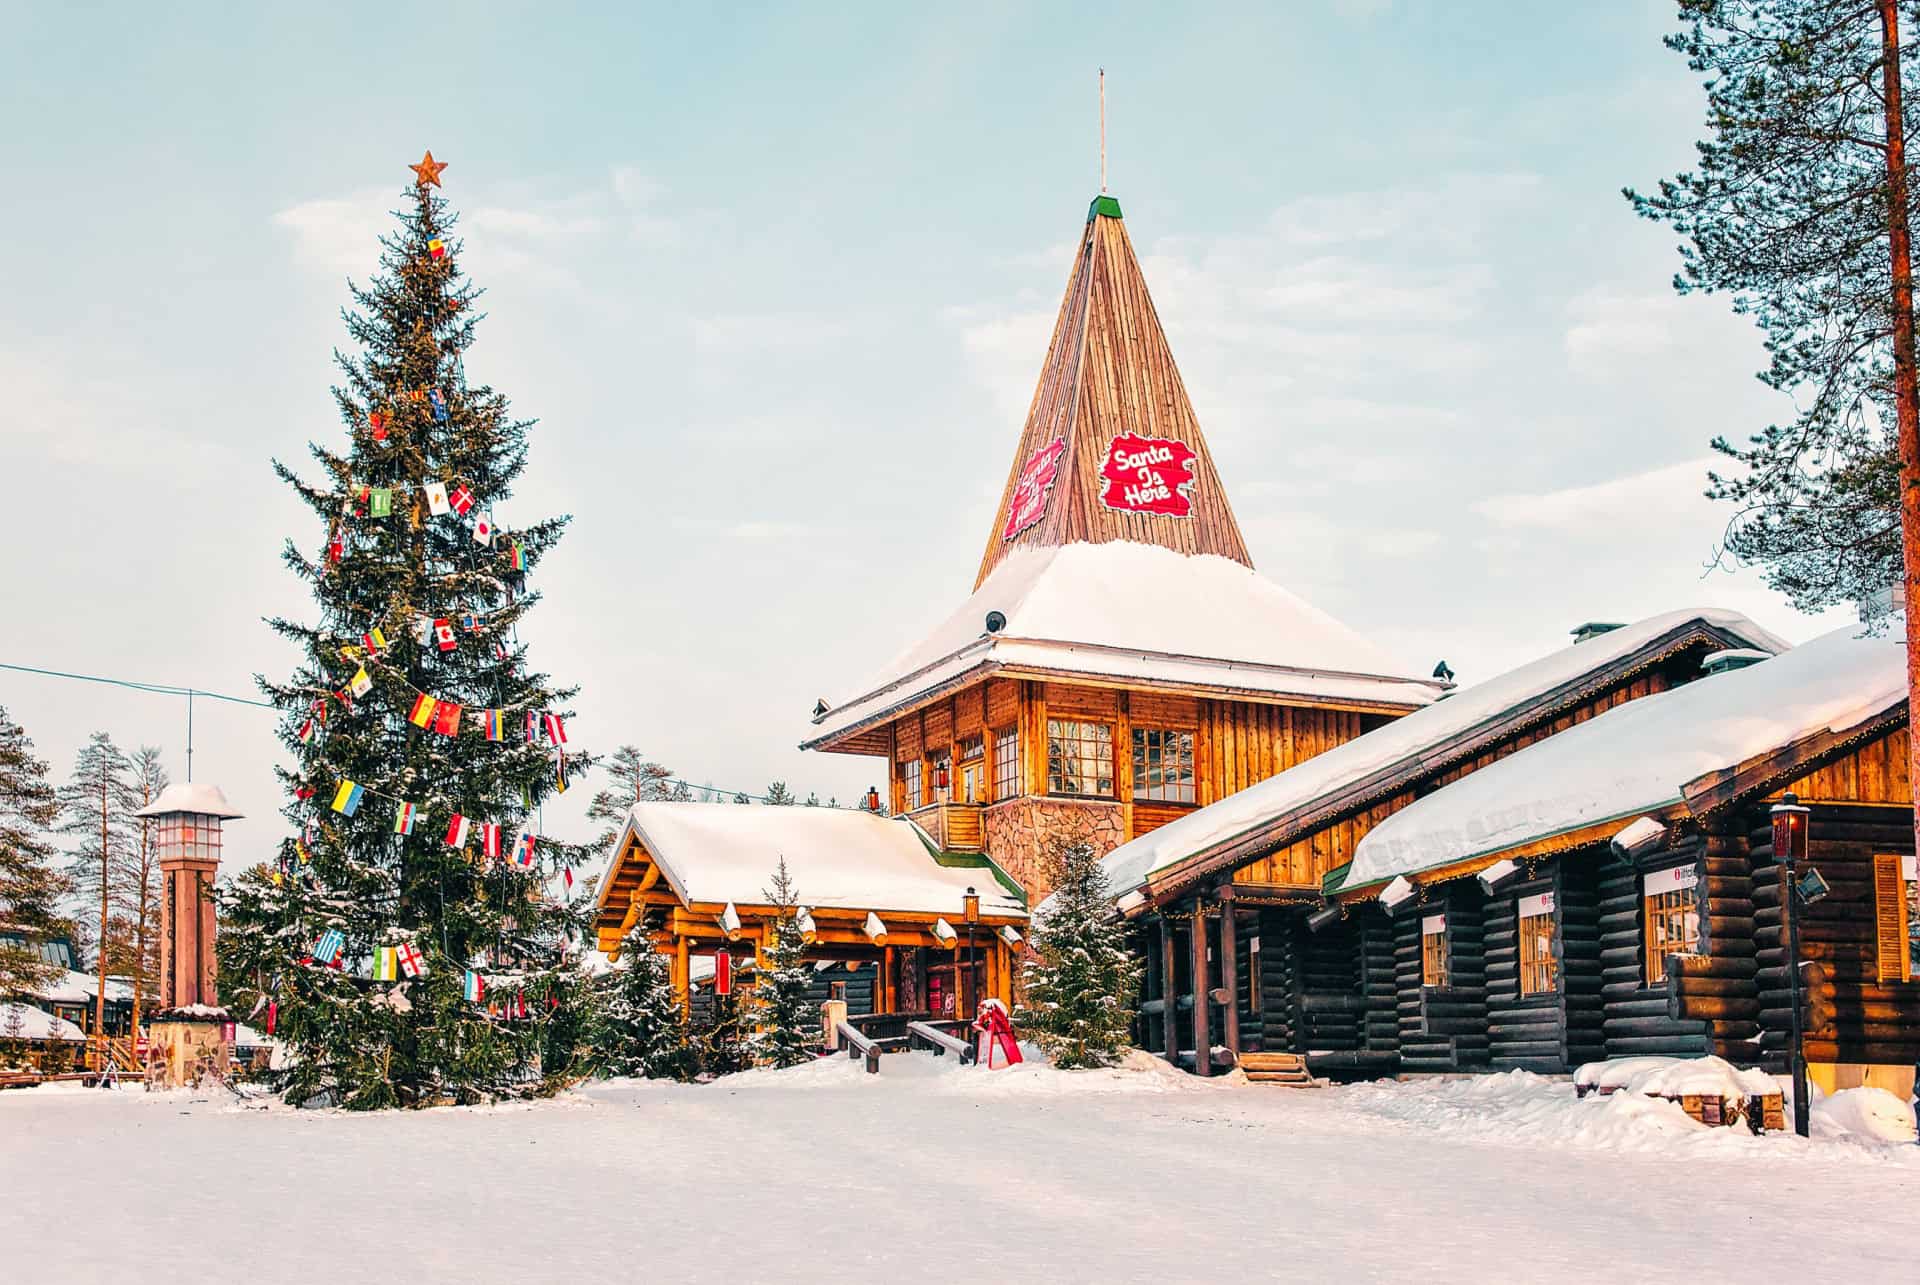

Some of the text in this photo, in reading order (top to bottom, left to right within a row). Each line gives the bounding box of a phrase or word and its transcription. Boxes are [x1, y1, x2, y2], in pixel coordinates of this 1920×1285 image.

[1114, 445, 1173, 471] Santa
[1137, 466, 1164, 488] Is
[1124, 484, 1171, 506] Here
